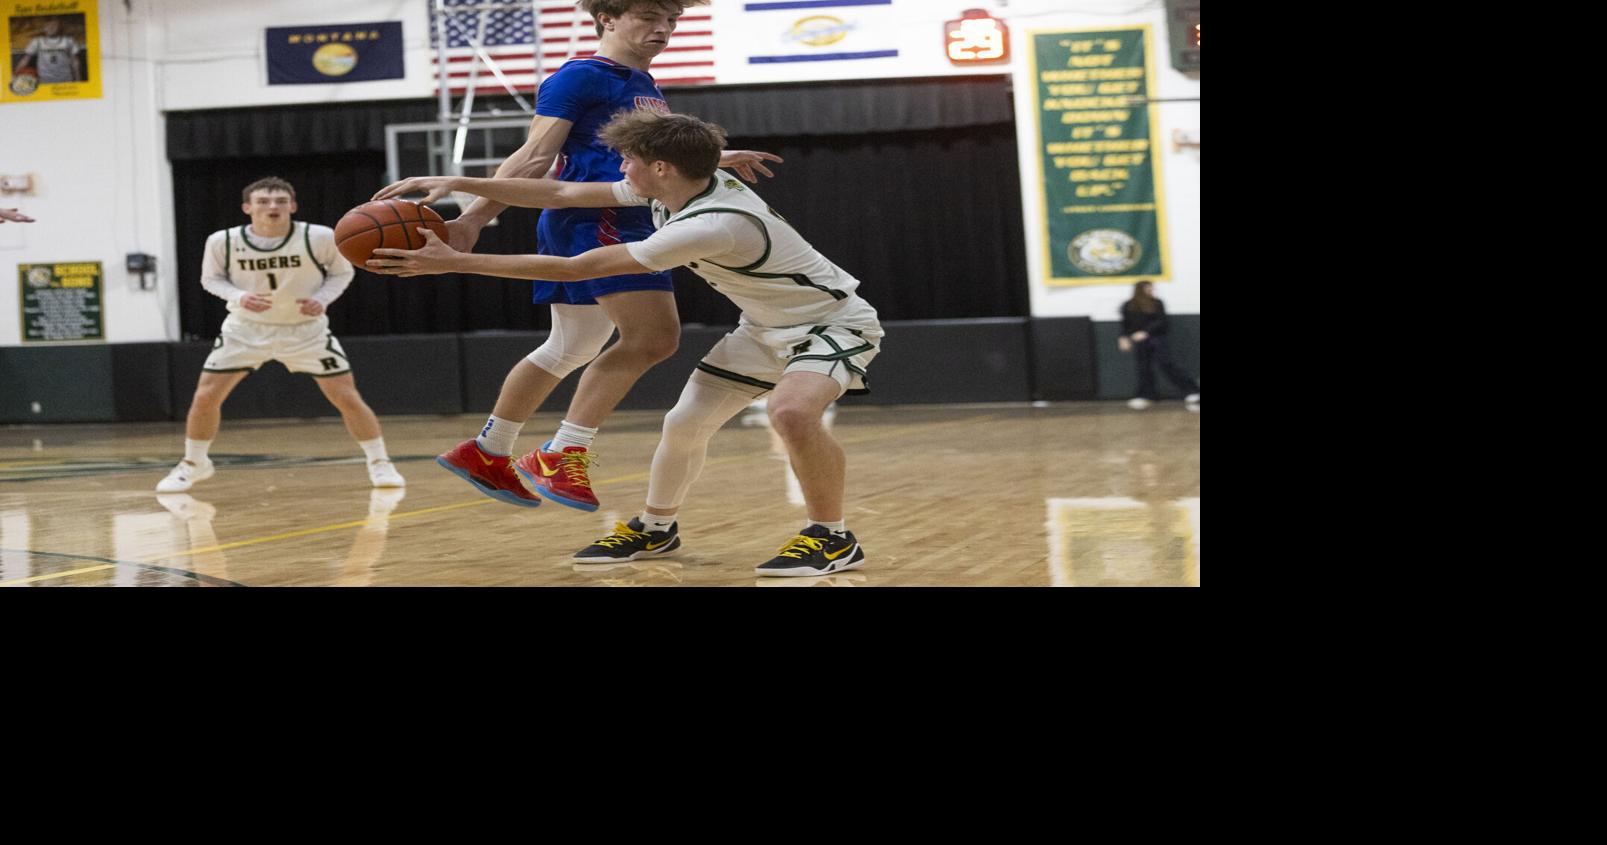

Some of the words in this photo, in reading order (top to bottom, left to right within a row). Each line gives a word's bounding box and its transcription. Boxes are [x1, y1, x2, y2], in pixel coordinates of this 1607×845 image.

[288, 30, 379, 45] MONTANA
[1067, 54, 1116, 67] NOT
[1040, 67, 1145, 82] WHETHER
[1048, 83, 1095, 96] YOU
[1097, 81, 1139, 94] GET
[1061, 110, 1131, 124] DOWN
[1046, 140, 1149, 155] WHETHER
[1053, 155, 1100, 168] YOU
[1103, 153, 1145, 166] GET
[1069, 168, 1129, 182] BACK
[237, 255, 302, 271] TIGERS
[267, 273, 278, 290] 1
[319, 357, 340, 371] R
